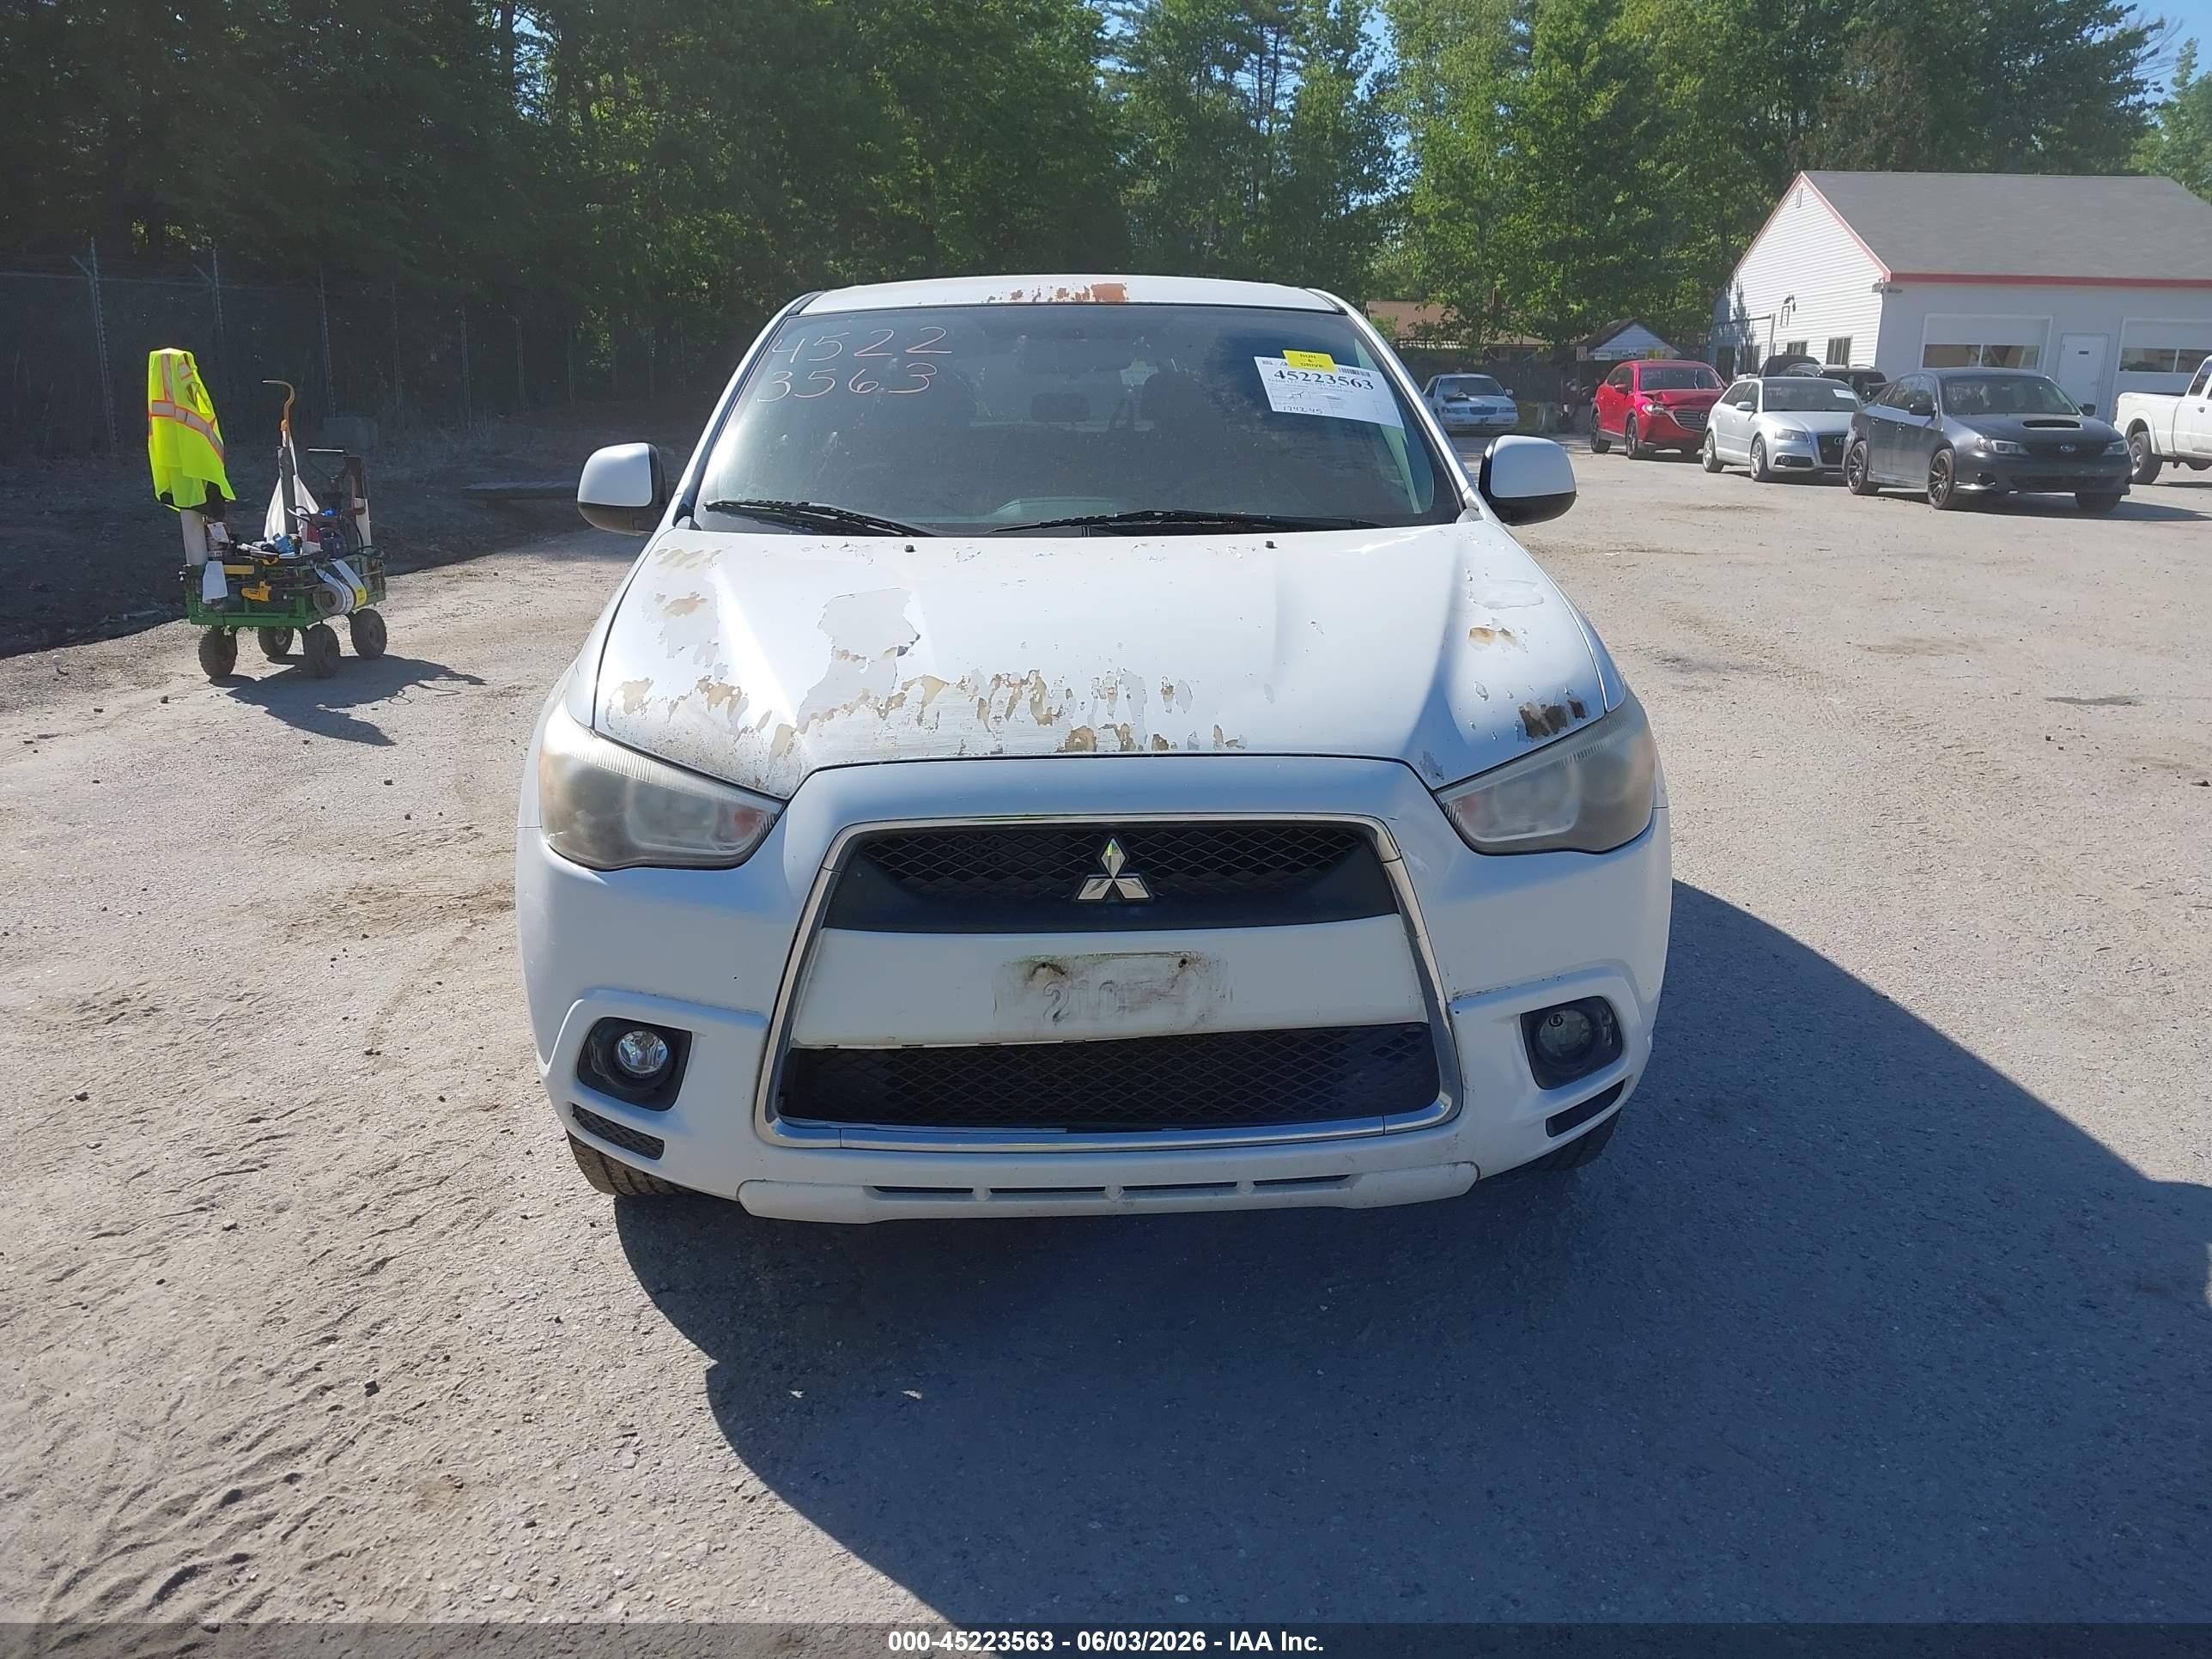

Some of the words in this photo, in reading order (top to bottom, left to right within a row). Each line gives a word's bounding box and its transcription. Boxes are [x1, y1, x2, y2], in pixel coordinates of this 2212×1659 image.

[772, 326, 953, 364] 4522
[757, 362, 938, 403] 3563
[1273, 369, 1375, 391] 45223563
